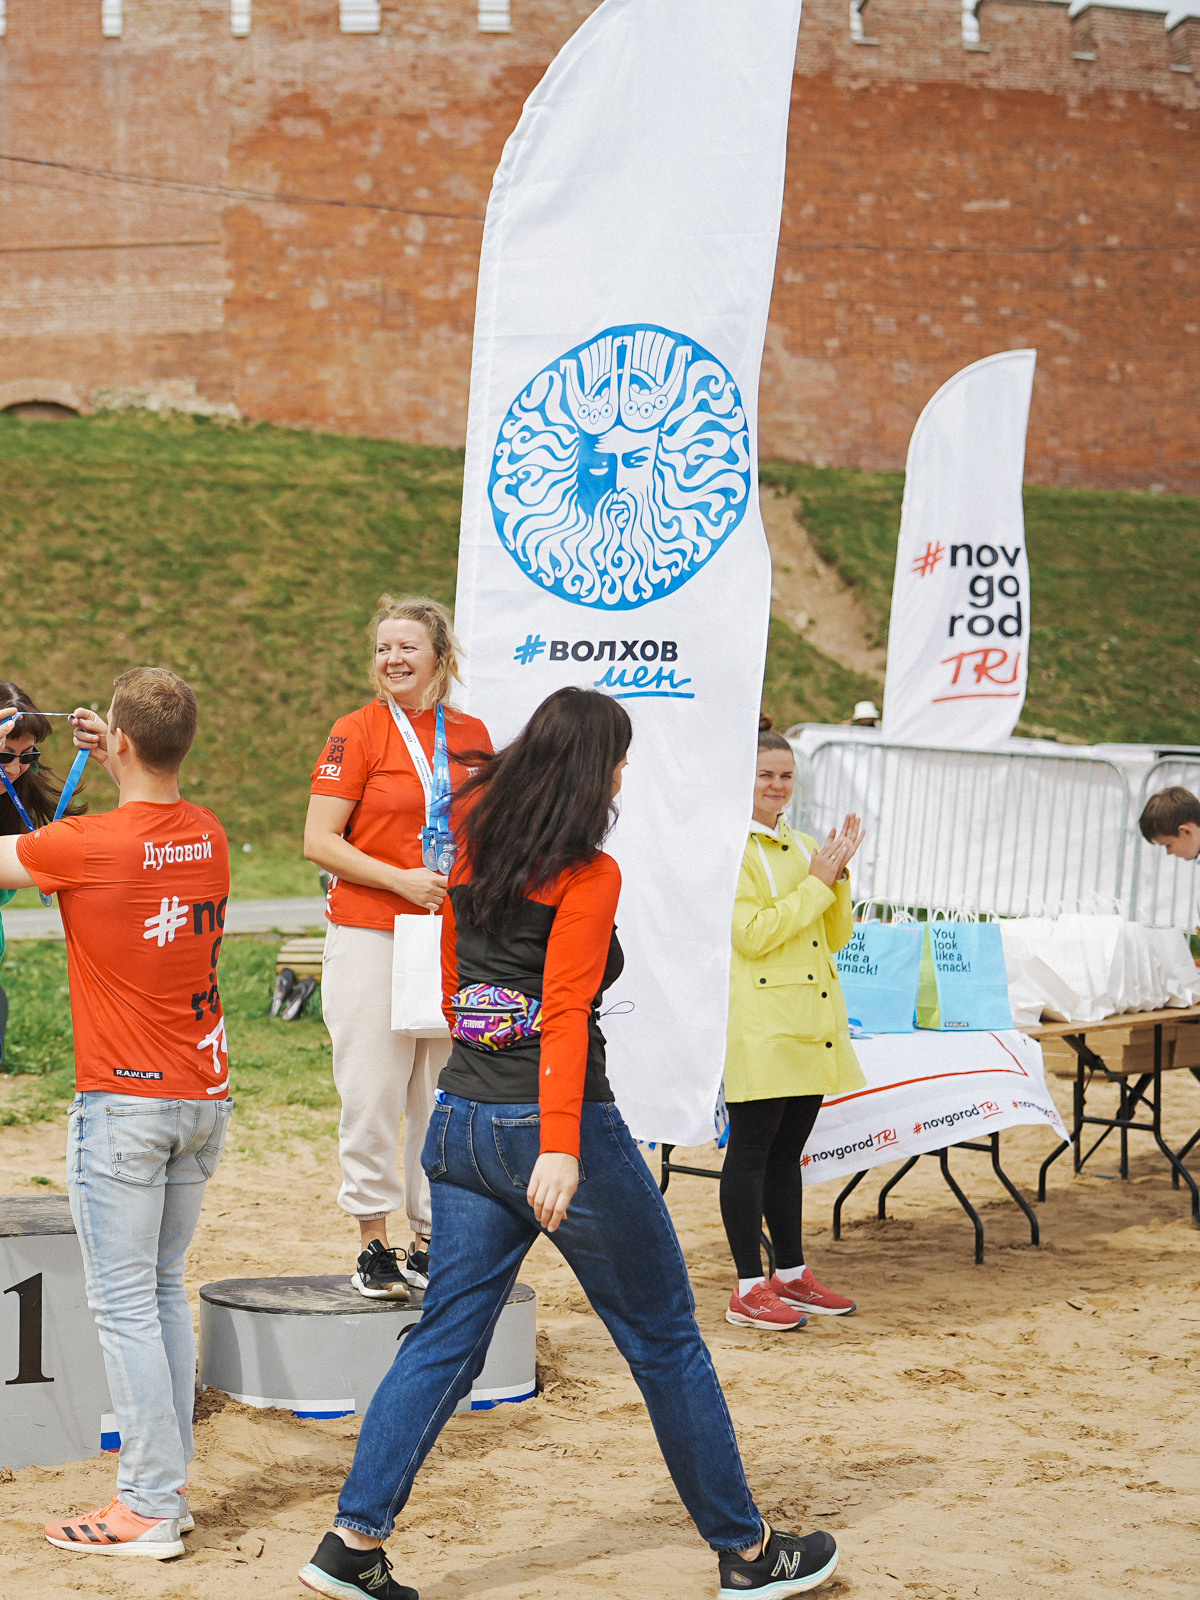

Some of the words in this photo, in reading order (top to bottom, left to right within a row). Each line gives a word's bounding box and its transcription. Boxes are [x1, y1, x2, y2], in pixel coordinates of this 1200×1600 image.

[911, 540, 1021, 578] #nov
[969, 574, 1020, 608] go
[949, 601, 1022, 637] rod
[513, 634, 678, 665] #ВОЛХОВ
[941, 648, 1021, 685] TRI
[329, 744, 345, 755] go
[326, 752, 344, 764] od
[142, 833, 213, 871] Дубовой
[850, 931, 865, 941] ou
[932, 928, 956, 940] You
[843, 941, 865, 952] ook
[934, 939, 958, 950] look
[837, 951, 860, 963] like
[862, 955, 870, 964] a
[935, 951, 955, 962] like
[956, 954, 963, 962] a
[836, 962, 878, 976] snack!
[936, 962, 972, 973] snack!
[3, 1272, 55, 1385] 1
